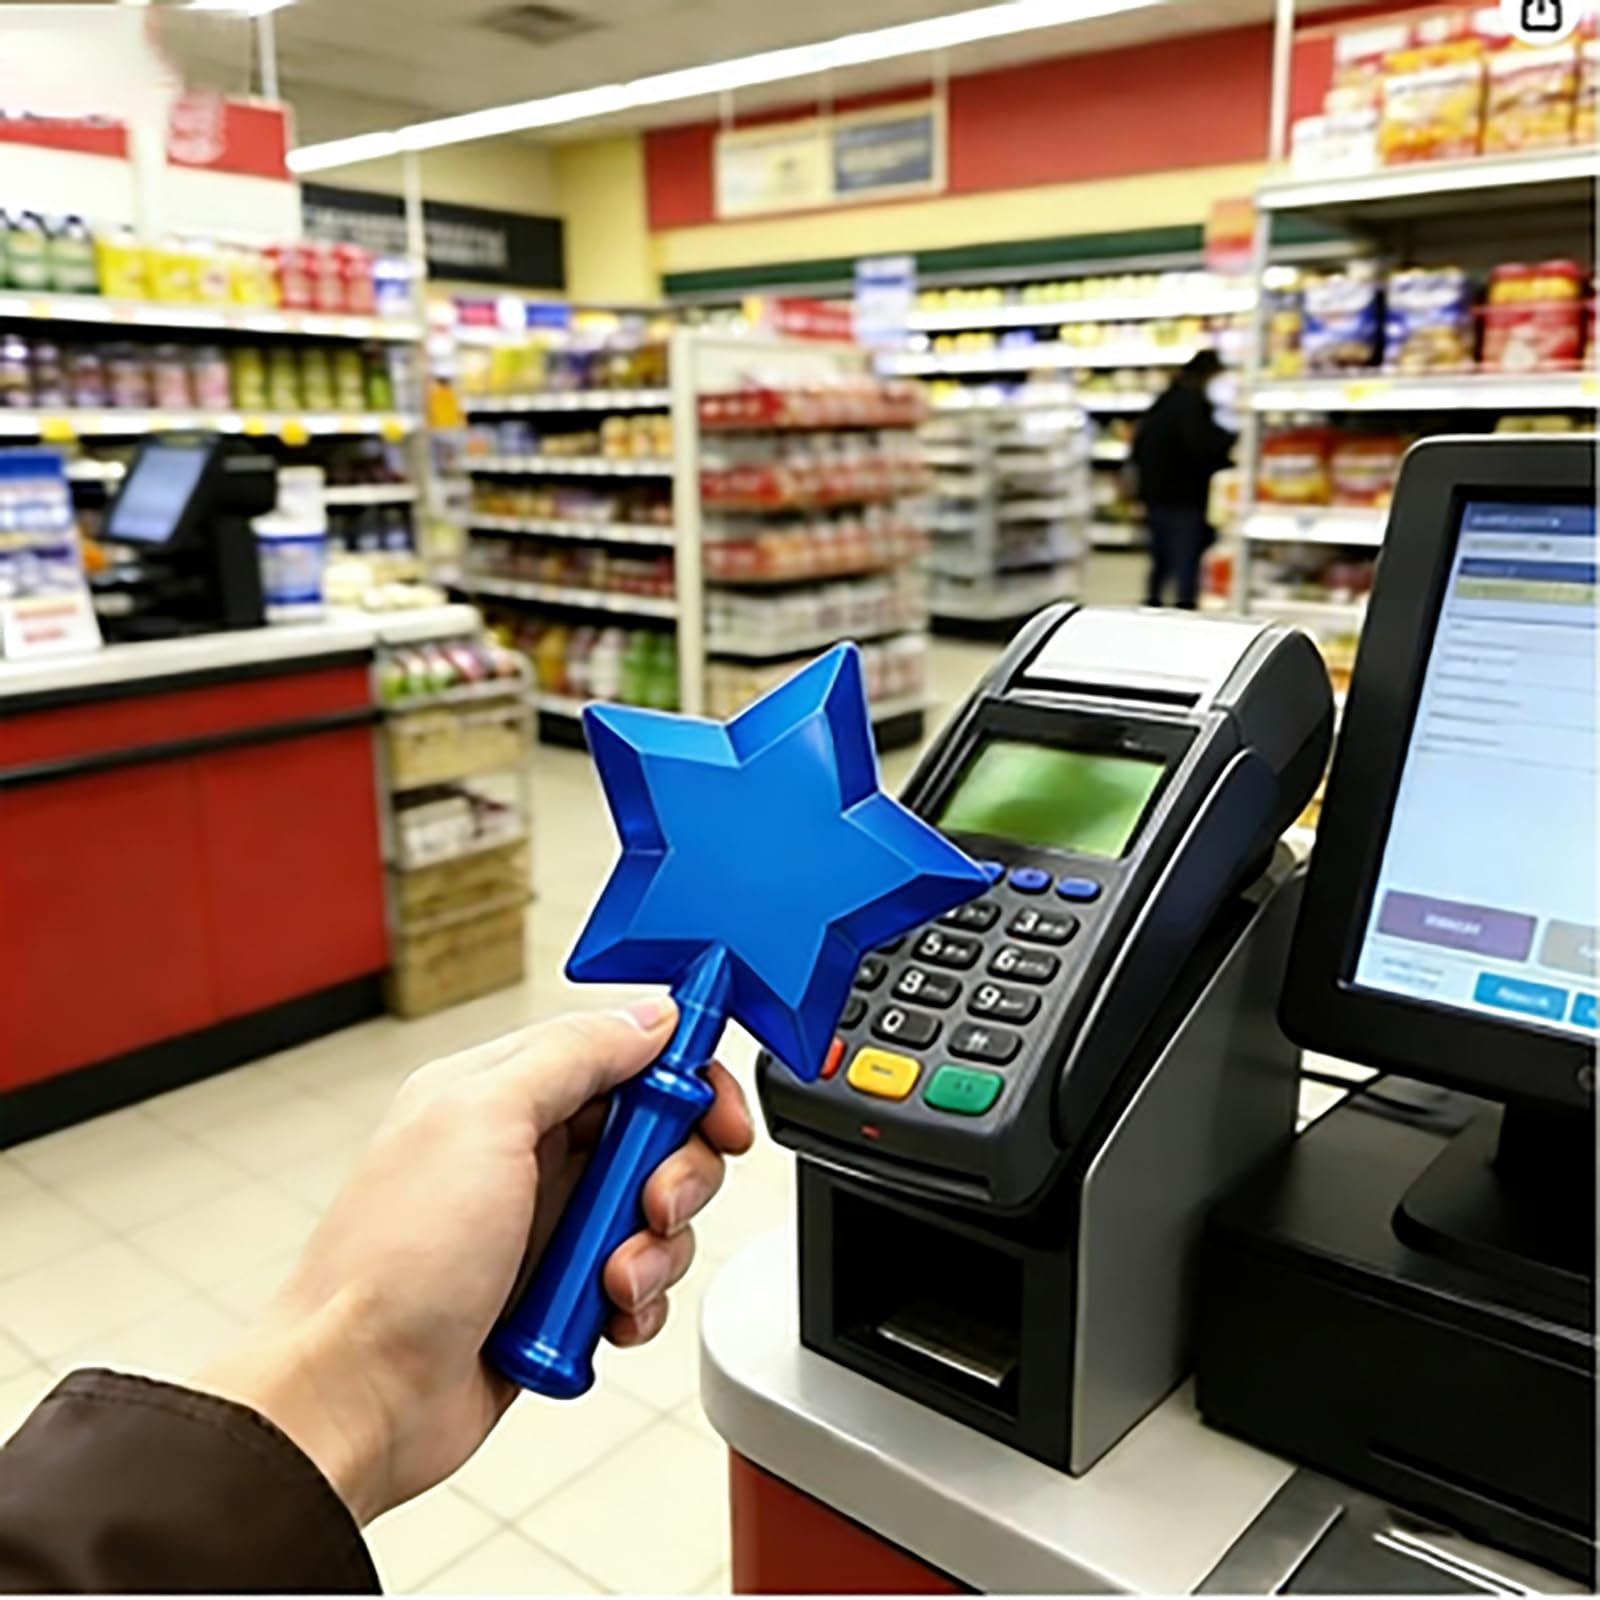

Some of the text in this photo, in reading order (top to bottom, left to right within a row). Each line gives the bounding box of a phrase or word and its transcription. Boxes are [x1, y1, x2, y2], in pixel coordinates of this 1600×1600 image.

[1013, 908, 1039, 933] 3
[920, 932, 943, 956] 5
[995, 947, 1021, 972] 6
[899, 969, 925, 994] 8
[975, 985, 1000, 1009] 9
[882, 1008, 906, 1033] 0
